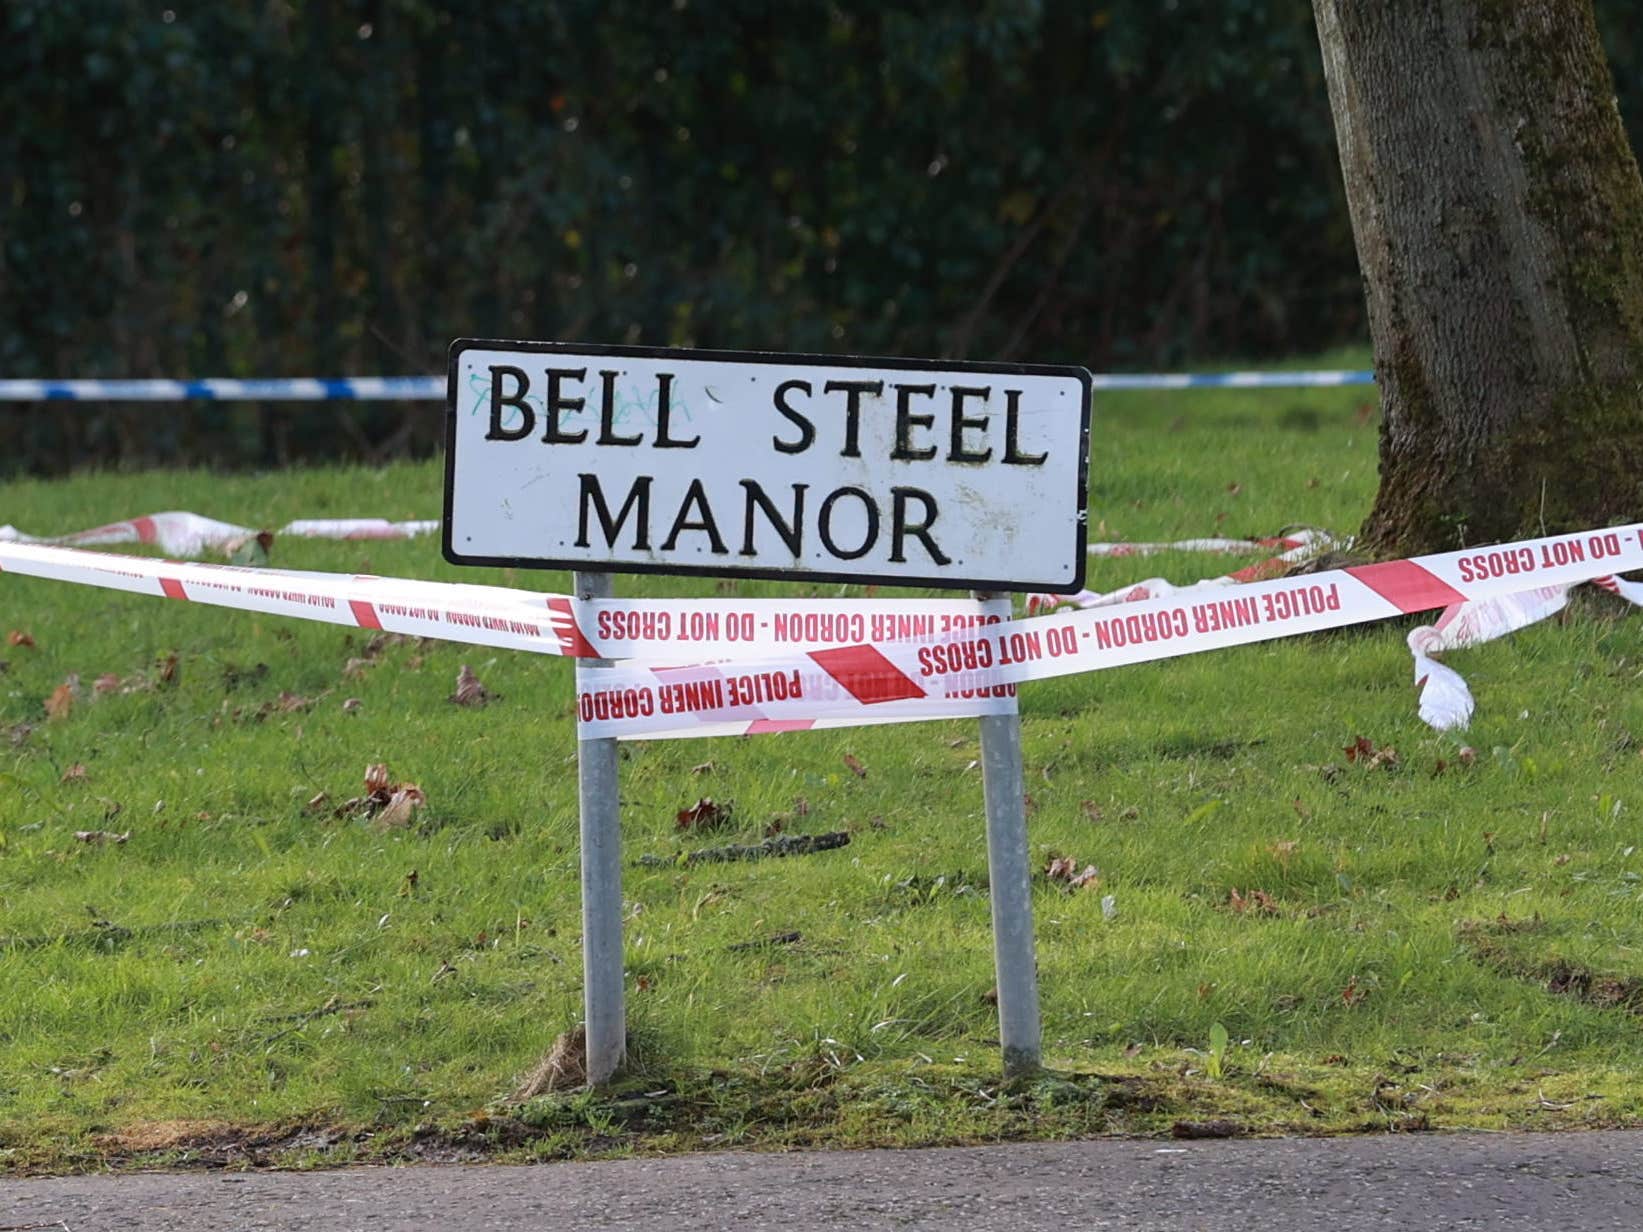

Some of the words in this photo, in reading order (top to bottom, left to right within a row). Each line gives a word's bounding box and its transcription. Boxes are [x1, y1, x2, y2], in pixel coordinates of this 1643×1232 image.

[485, 364, 701, 449] BELL
[771, 379, 1049, 467] STEEL
[573, 473, 951, 566] MANOR
[1541, 539, 1585, 569] NOT
[1589, 533, 1621, 559] DO
[1458, 547, 1535, 583] CROSS
[1193, 596, 1260, 633] INNER
[1262, 583, 1341, 622] POLICE
[598, 610, 671, 640] CROSS
[677, 612, 719, 641] NOT
[726, 612, 755, 641] DO
[774, 613, 864, 642] CORDON
[871, 614, 934, 643] INNER
[1046, 625, 1079, 657] DO
[1095, 607, 1188, 650] CORDON
[918, 638, 993, 677] CROSS
[999, 631, 1042, 666] NOT
[578, 687, 654, 722] CORDO
[659, 679, 724, 714] INNER
[726, 669, 802, 707] POLICE
